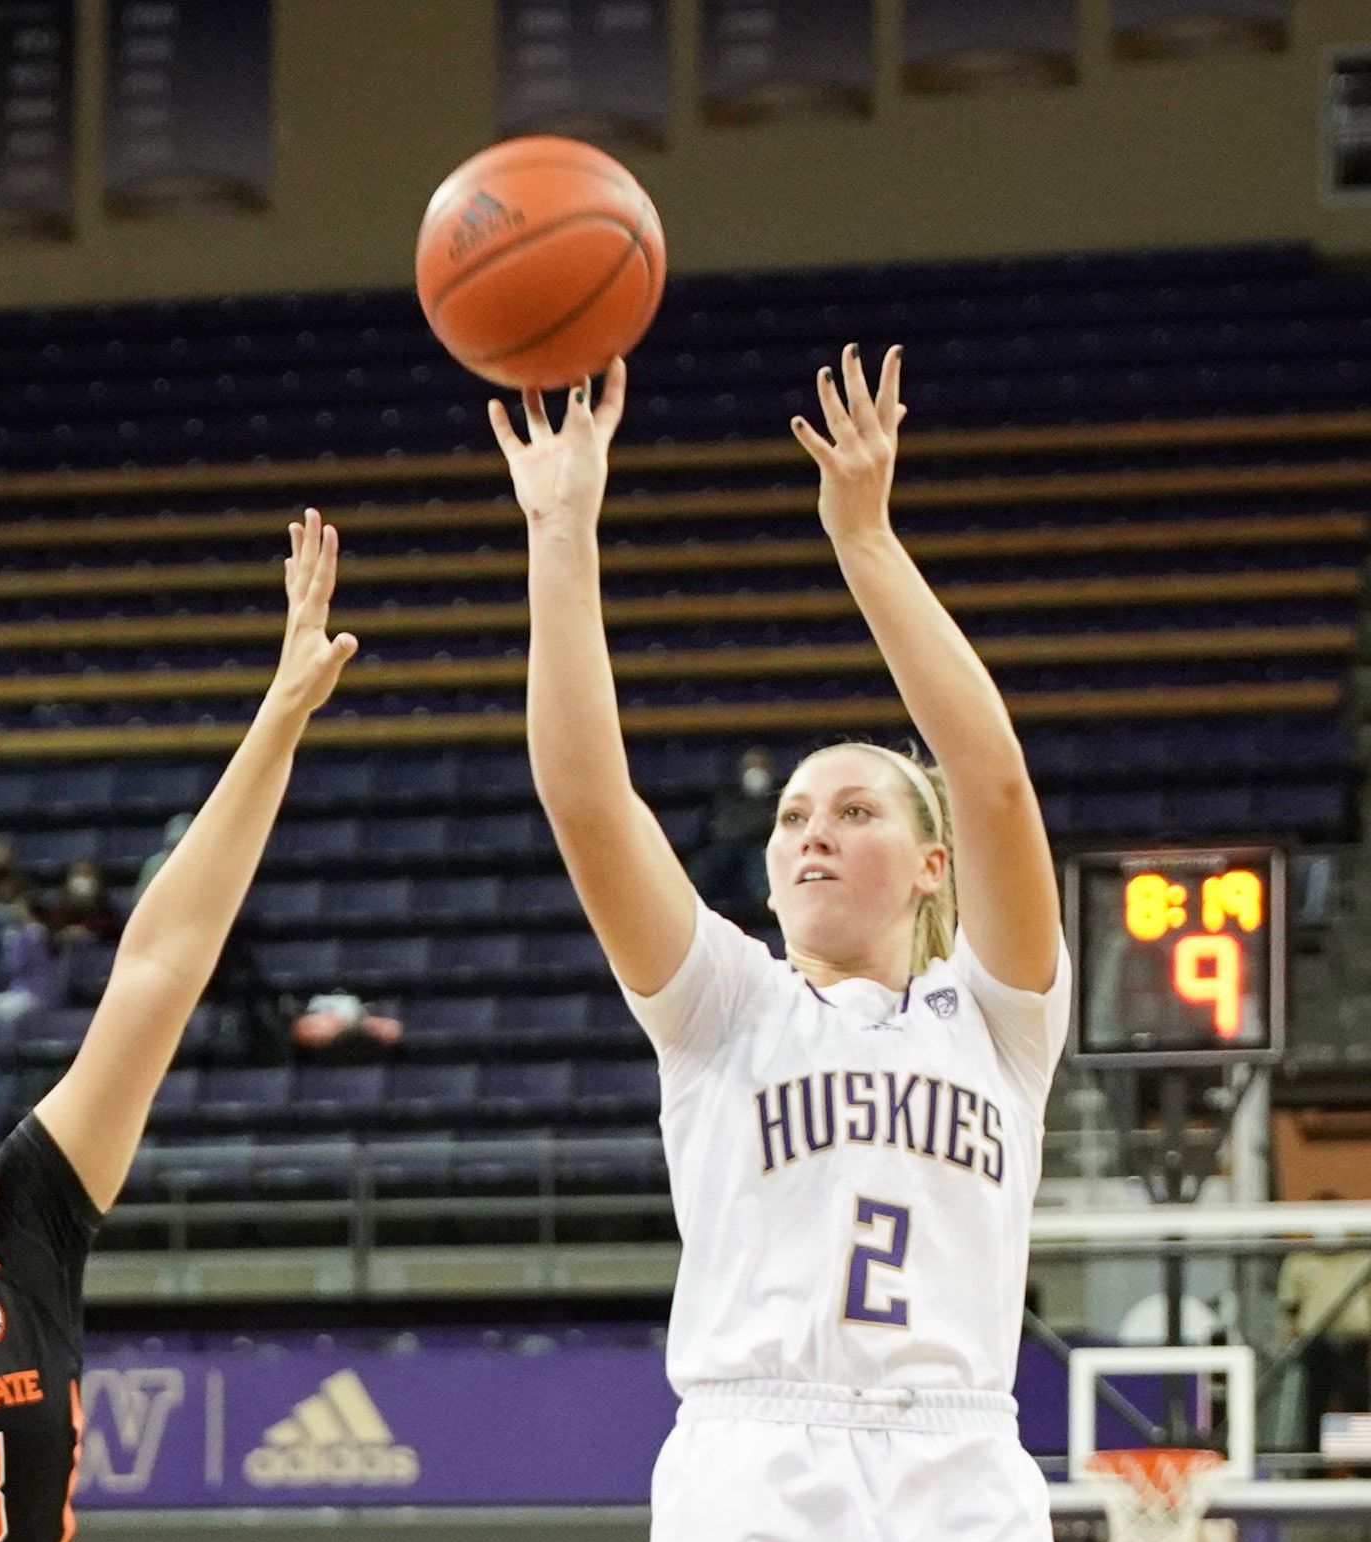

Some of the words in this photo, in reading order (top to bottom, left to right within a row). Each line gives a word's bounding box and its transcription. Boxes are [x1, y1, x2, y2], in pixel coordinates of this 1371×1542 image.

[1173, 931, 1242, 1041] 9
[755, 1069, 1007, 1188] HUSKIES
[840, 1193, 911, 1329] 2
[242, 1444, 419, 1488] adidas
